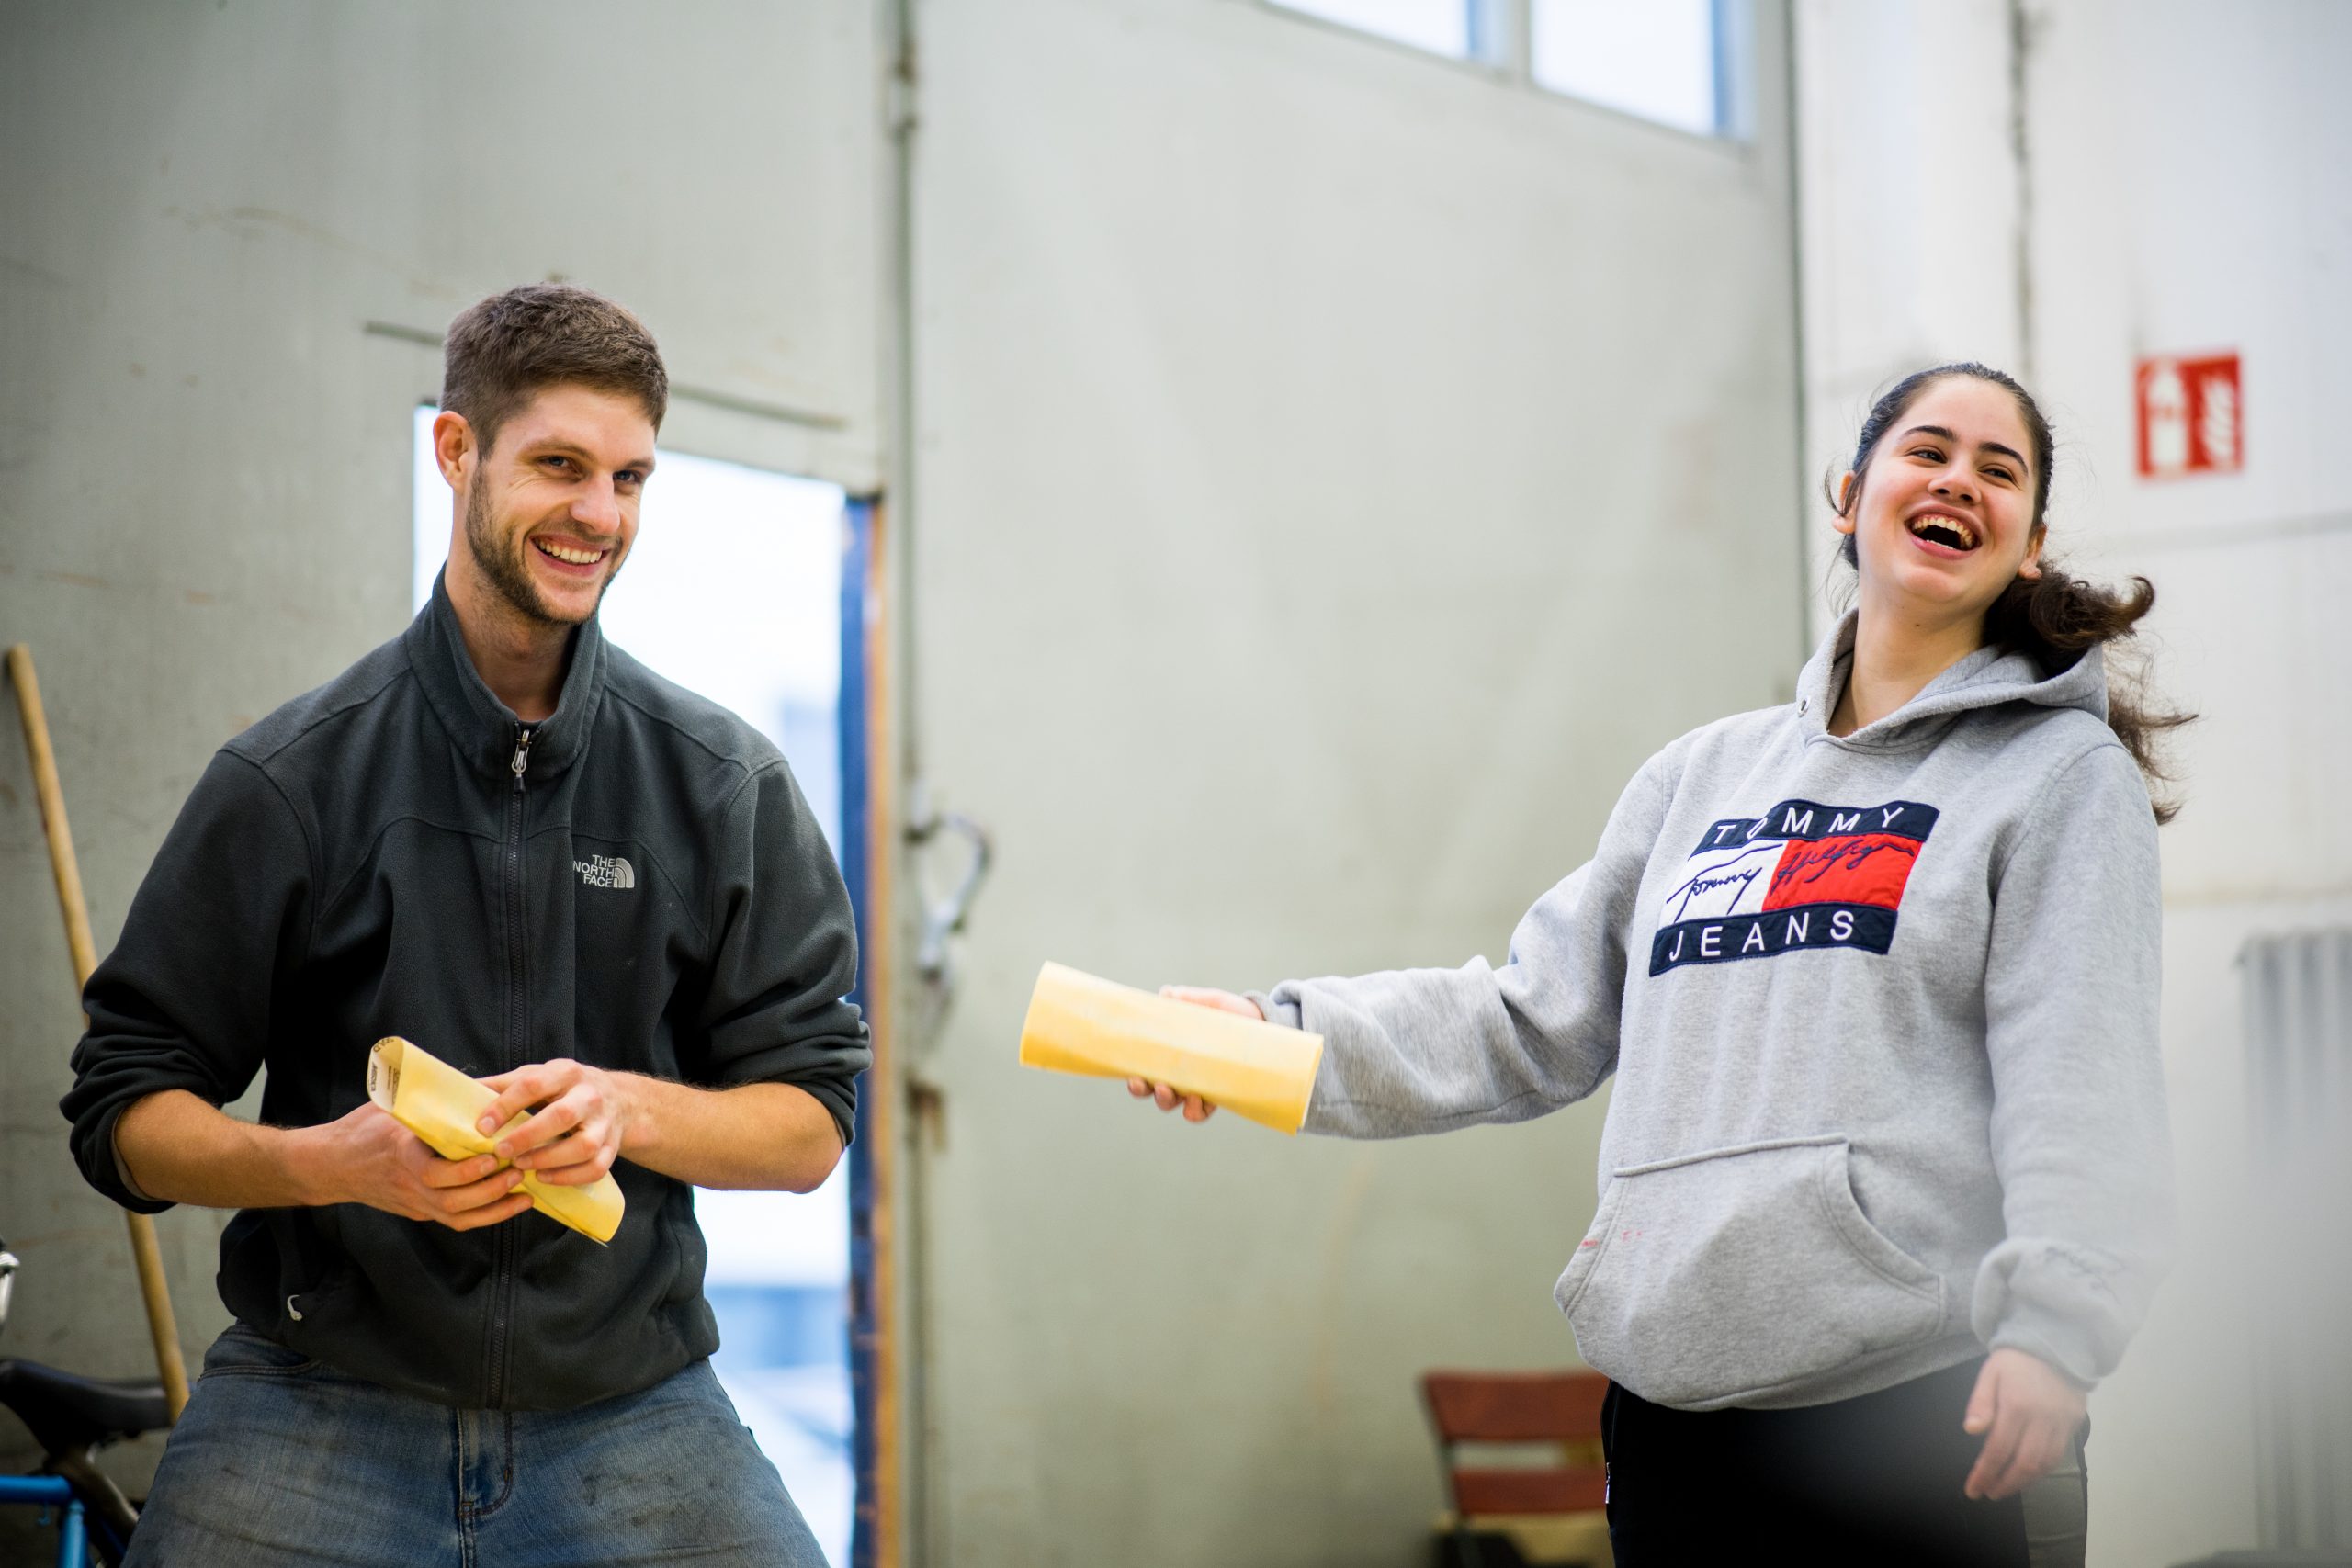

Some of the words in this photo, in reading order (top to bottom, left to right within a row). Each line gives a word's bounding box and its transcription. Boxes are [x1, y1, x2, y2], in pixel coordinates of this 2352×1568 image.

[1713, 807, 1904, 844] TOMMY
[572, 861, 615, 878] NORTH
[592, 854, 616, 868] THE
[583, 874, 614, 887] FACE
[1666, 843, 1783, 923] Tommy
[1668, 910, 1855, 962] JEANS
